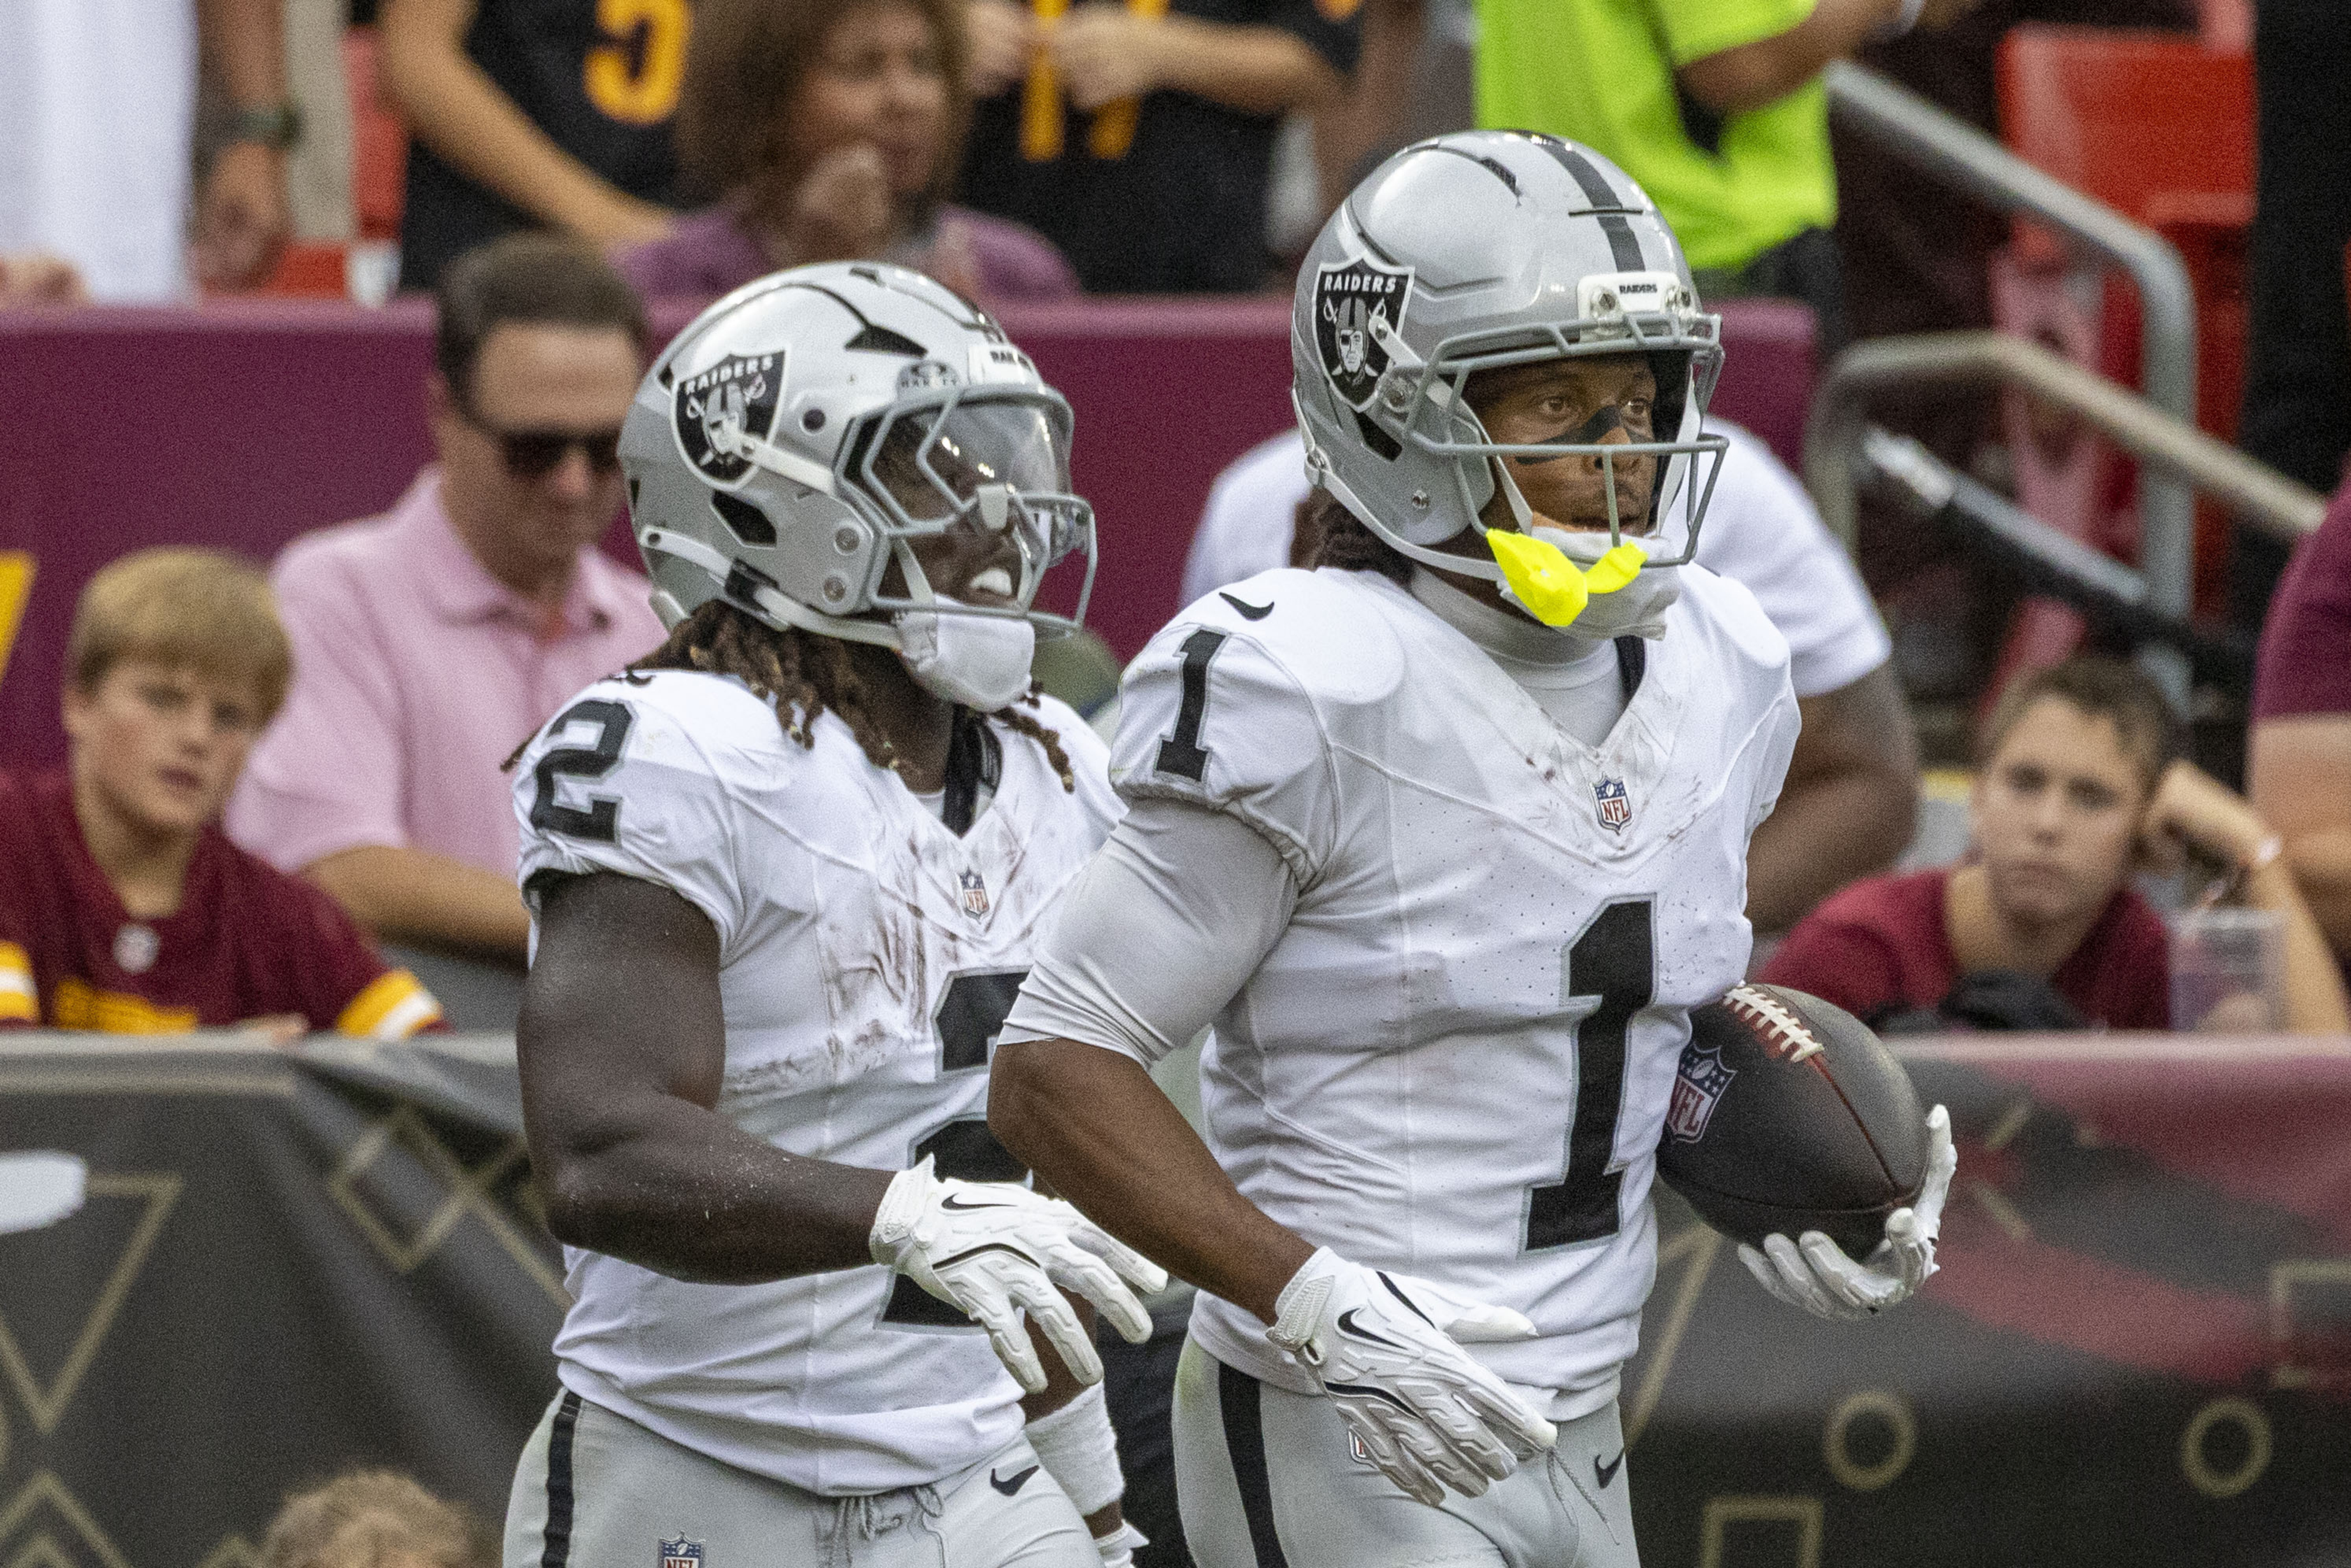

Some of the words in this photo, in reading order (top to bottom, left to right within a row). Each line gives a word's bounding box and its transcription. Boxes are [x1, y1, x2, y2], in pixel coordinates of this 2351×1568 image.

[1324, 273, 1396, 293] RAIDERS
[1619, 284, 1657, 294] RAIDERS
[685, 355, 773, 395] RAIDERS
[1153, 626, 1231, 785] 1
[529, 698, 636, 844] 2
[1602, 799, 1629, 823] NFL
[966, 891, 988, 912] NFL
[1519, 893, 1657, 1255] 1
